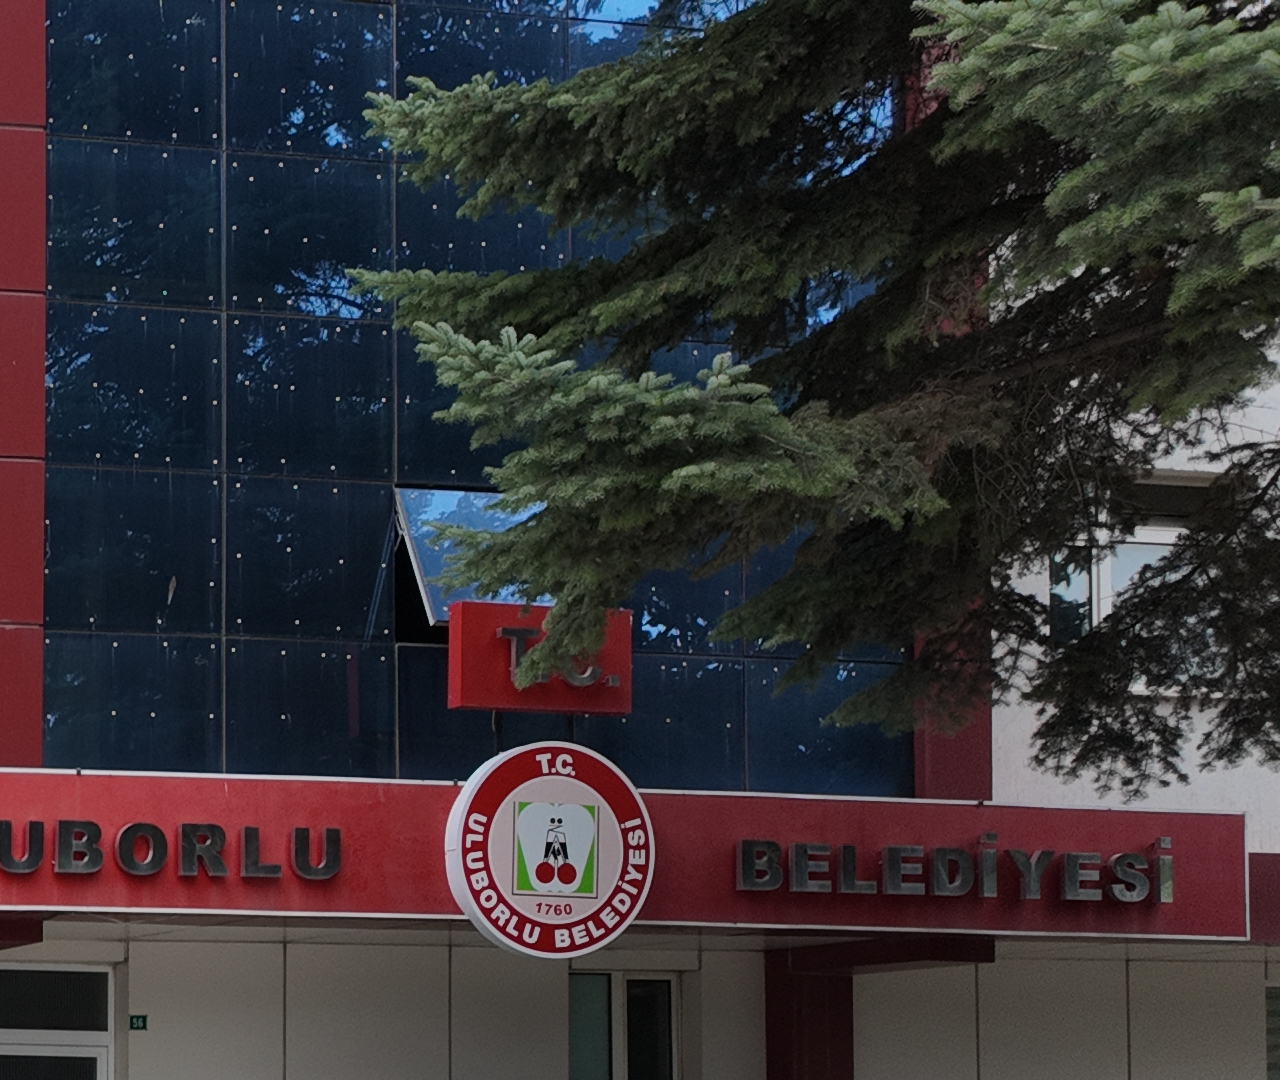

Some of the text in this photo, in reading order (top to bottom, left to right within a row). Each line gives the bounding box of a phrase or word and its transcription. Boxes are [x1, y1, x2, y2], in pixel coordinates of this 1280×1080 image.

[535, 752, 576, 777] T.C.
[465, 811, 541, 945] ULUBORLU
[554, 817, 646, 949] BELEDİYESİ
[735, 831, 1175, 904] BELEDİYESİ
[535, 902, 574, 917] 1760
[132, 1017, 144, 1028] 56
